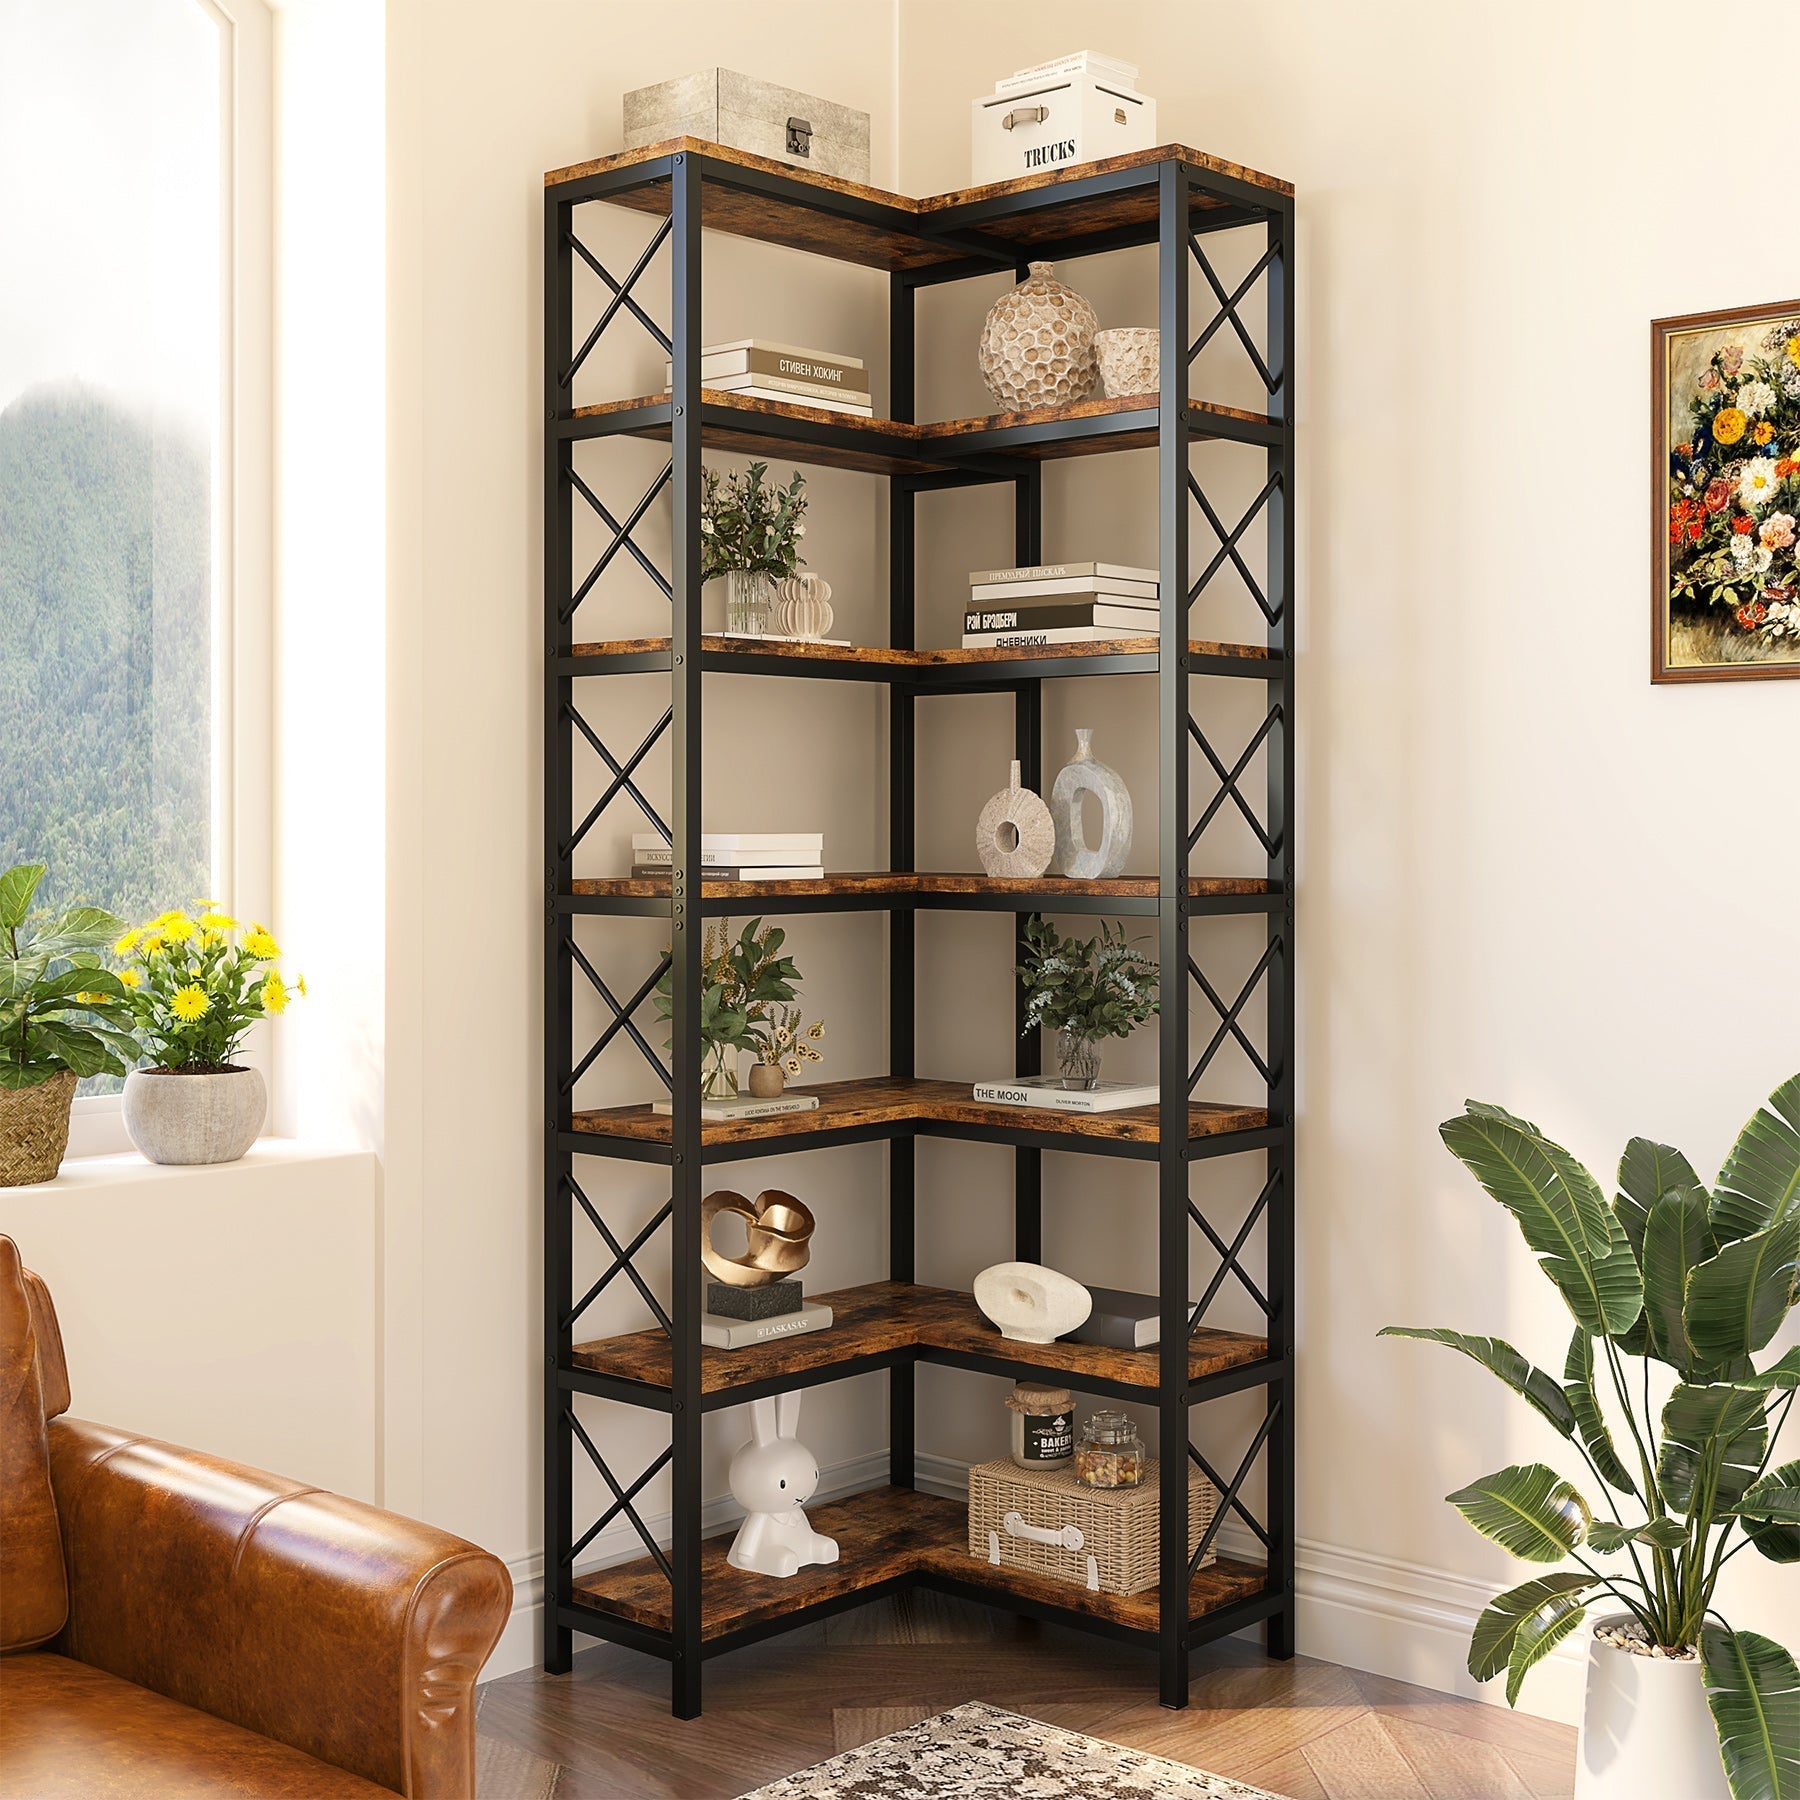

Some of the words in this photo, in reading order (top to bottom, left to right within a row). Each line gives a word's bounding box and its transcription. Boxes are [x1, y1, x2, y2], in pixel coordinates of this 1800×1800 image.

[1024, 139, 1076, 168] TRUCKS
[779, 359, 811, 377] СТИВЕН
[813, 366, 844, 382] ХОКИНГ
[967, 612, 980, 630] РЭЙ
[982, 612, 1017, 629] БРЭДБЕРИ
[996, 635, 1047, 647] ДНЕВНИКИ
[976, 1088, 995, 1099] THE
[997, 1090, 1028, 1102] MOON
[765, 1320, 808, 1336] LASKASAS
